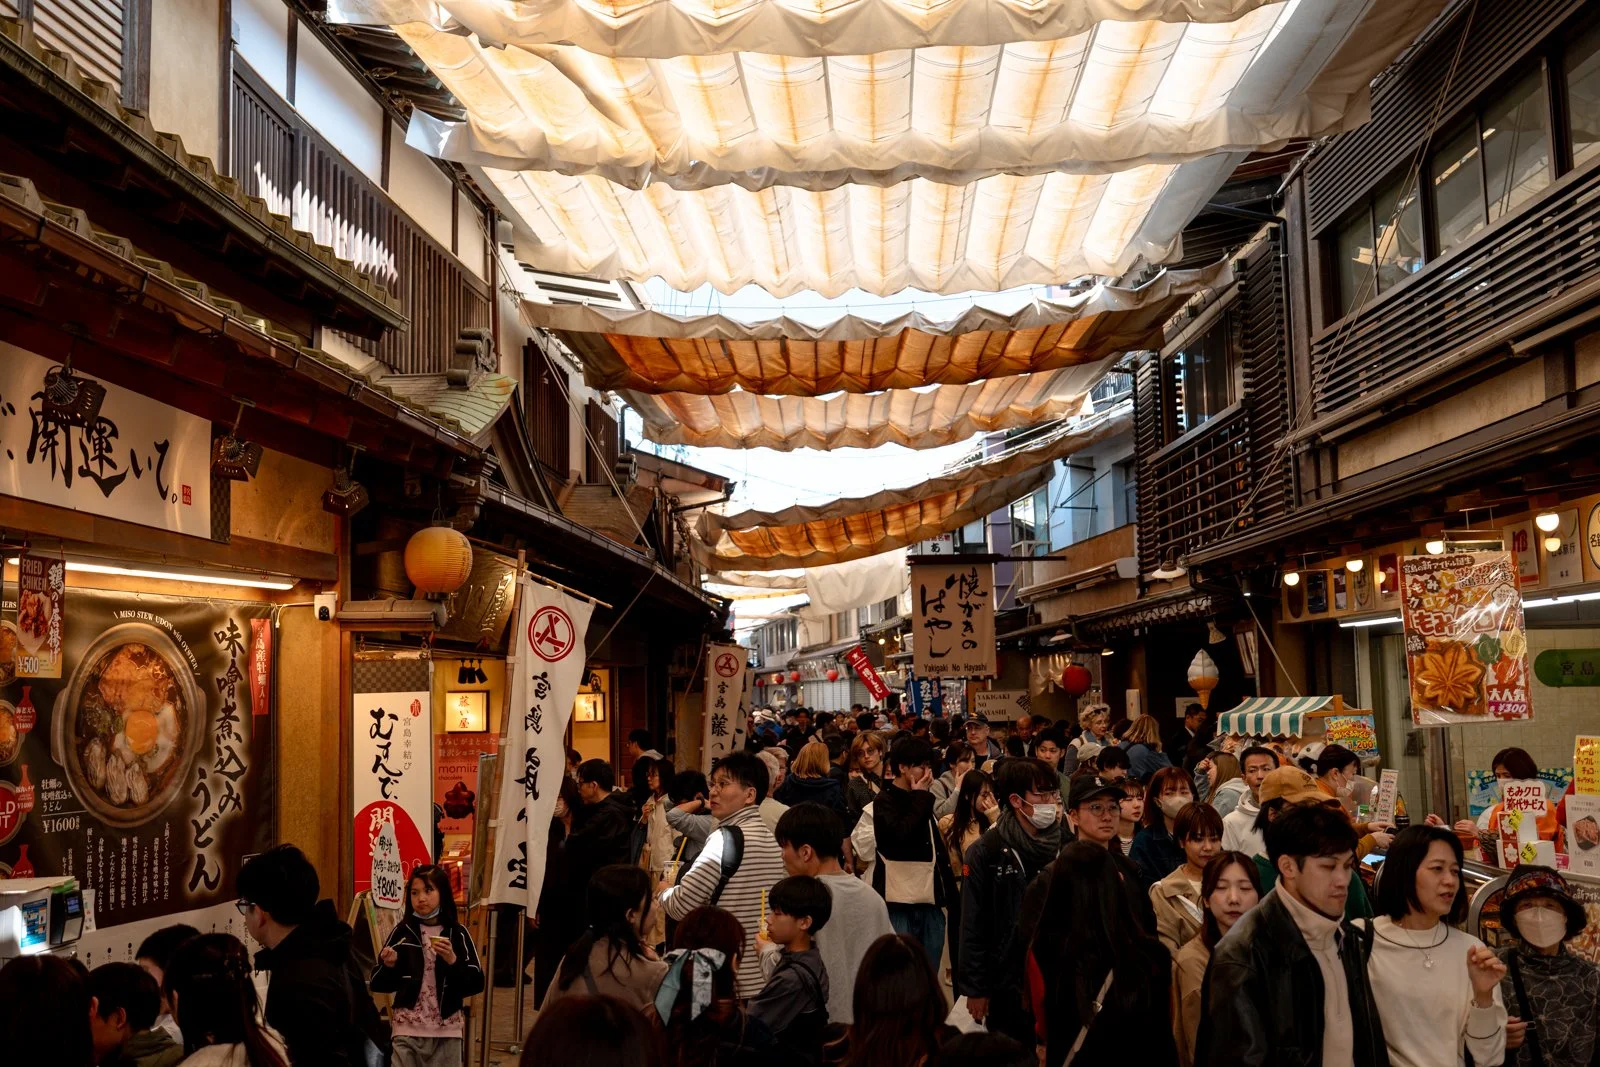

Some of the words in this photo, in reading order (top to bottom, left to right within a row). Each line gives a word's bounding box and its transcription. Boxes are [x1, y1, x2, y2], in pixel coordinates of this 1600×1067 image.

[21, 560, 42, 575] FRIED
[945, 567, 988, 650] 焼がきの
[920, 584, 953, 658] はやし
[119, 610, 136, 618] MISO
[137, 610, 154, 621] STEW
[155, 615, 174, 631] UDON
[181, 640, 198, 670] OYSTER
[18, 656, 38, 674] ¥500
[924, 663, 949, 674] Yakigaki
[952, 663, 961, 672] No
[964, 663, 987, 673] Hayashi
[1488, 688, 1526, 701] 大人気
[1498, 703, 1527, 713] ¥300
[402, 717, 412, 771] 宮島幸結び
[438, 763, 478, 773] momiiz
[41, 791, 73, 800] 味噌煮込み
[1506, 786, 1541, 797] もみクロ
[42, 801, 62, 812] うどん
[0, 815, 11, 829] T
[42, 817, 76, 834] ¥1600
